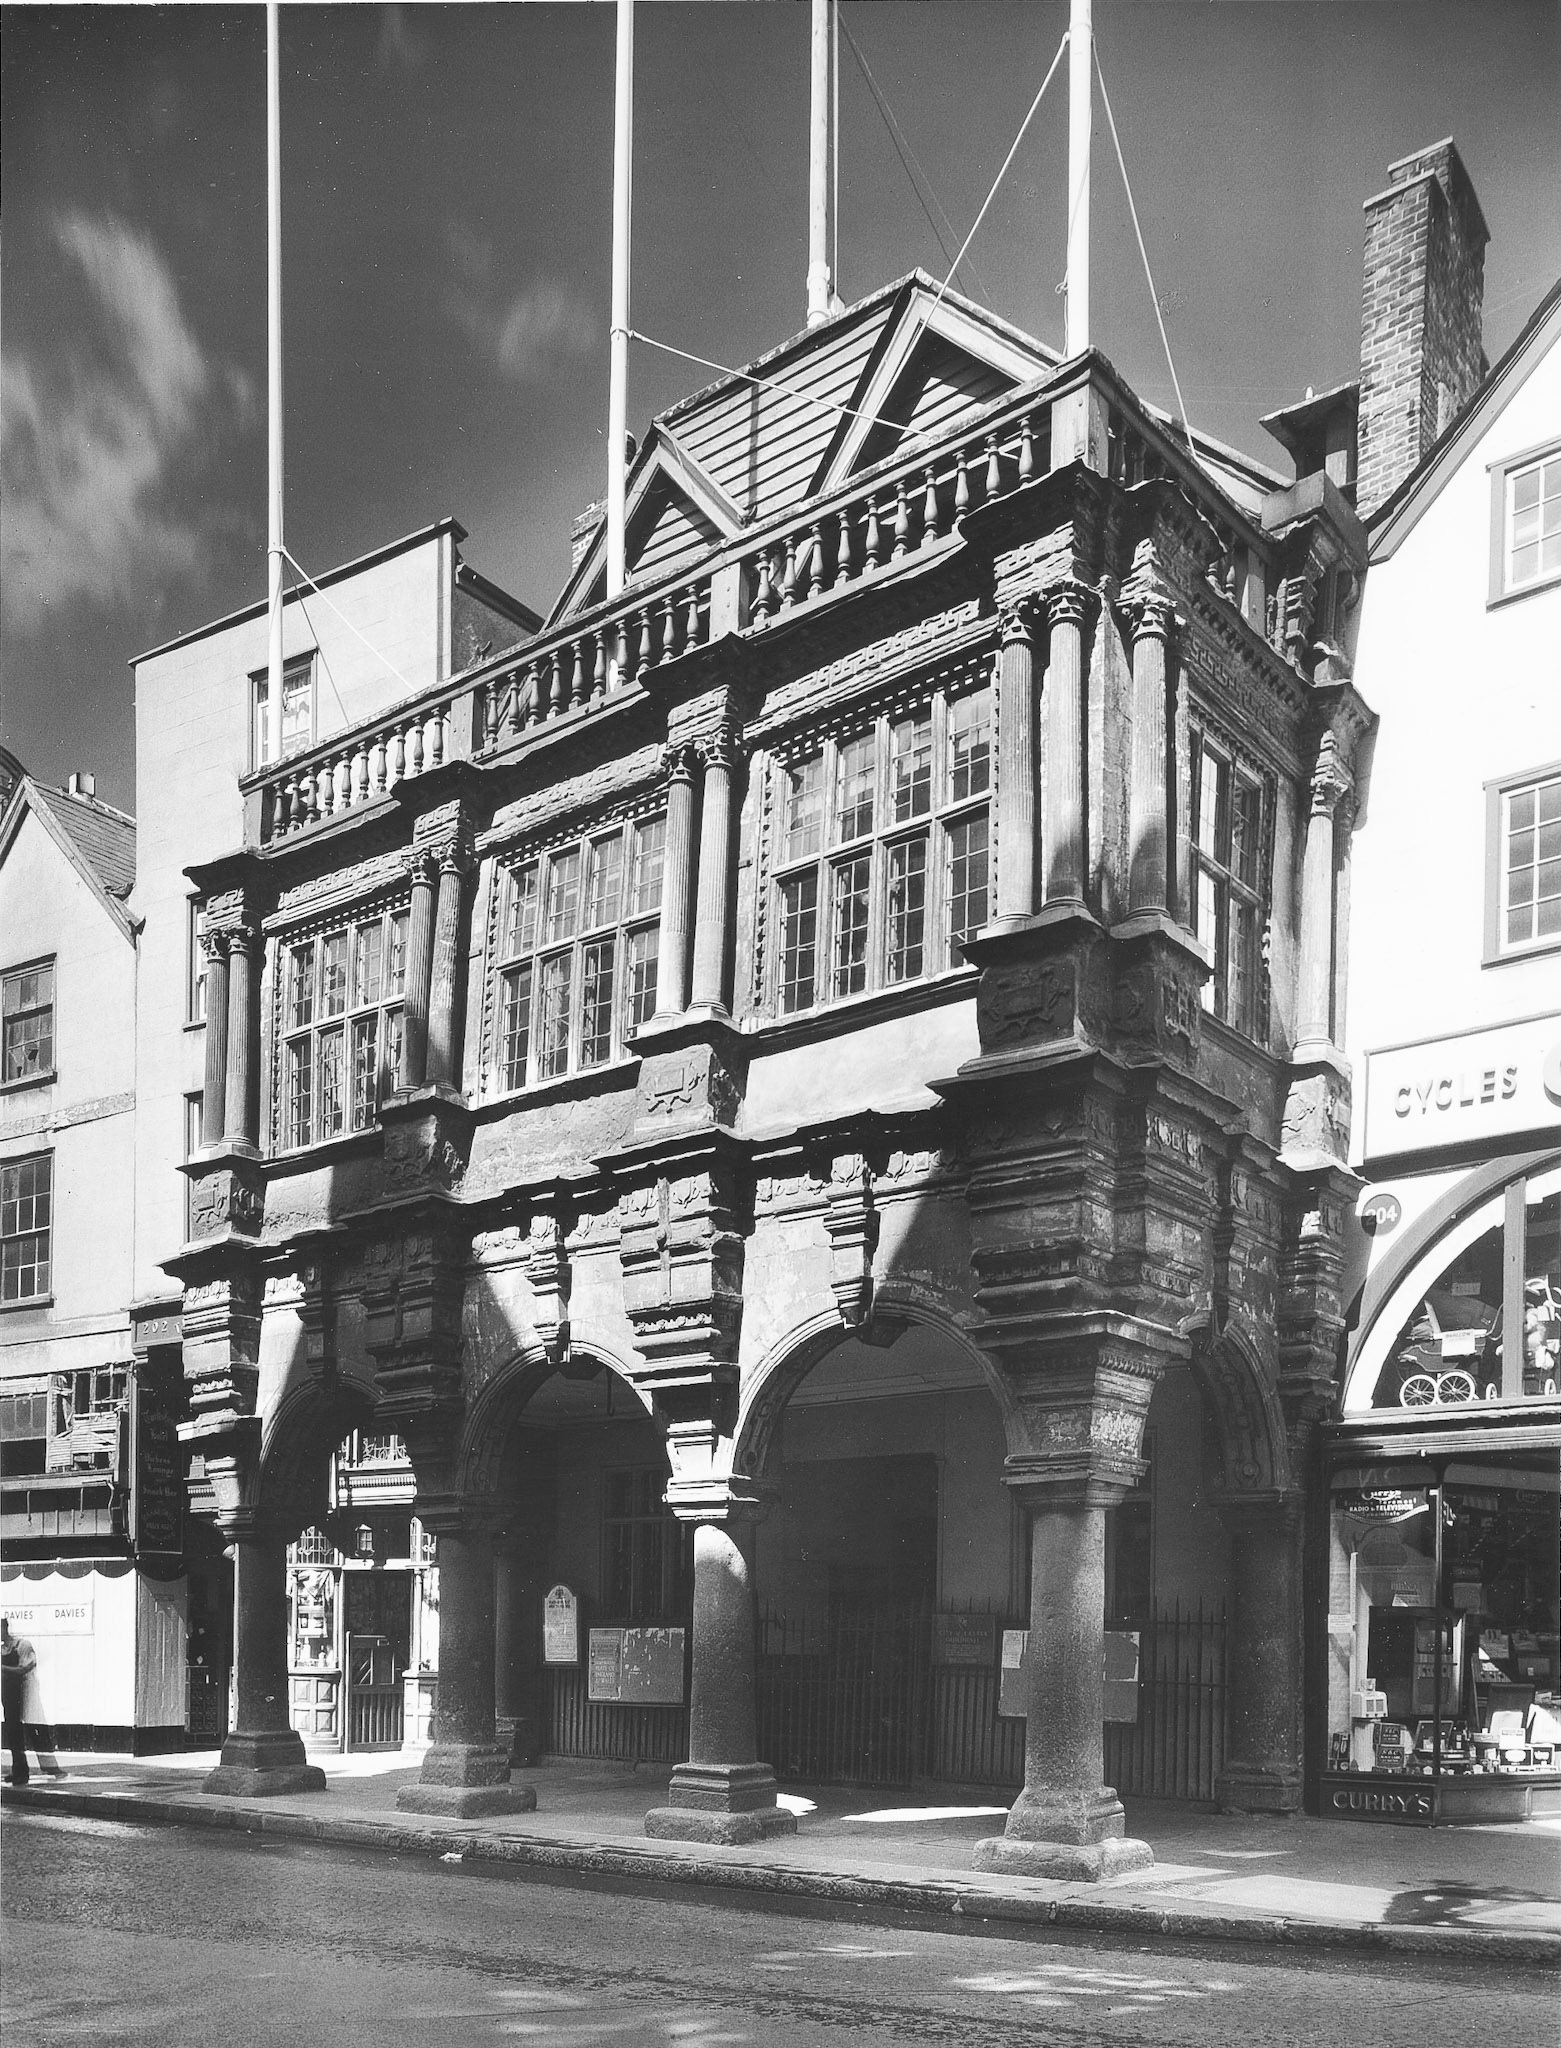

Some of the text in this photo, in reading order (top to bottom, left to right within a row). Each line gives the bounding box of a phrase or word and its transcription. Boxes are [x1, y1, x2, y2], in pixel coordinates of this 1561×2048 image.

[1394, 1064, 1519, 1118] CYCLES
[1364, 1204, 1398, 1225] 204
[143, 1320, 168, 1335] 202
[1375, 1503, 1414, 1512] TELEVISION
[4, 1610, 34, 1620] DAVIES
[55, 1608, 86, 1618] DAVIES
[1333, 1790, 1431, 1814] CURRY'S
